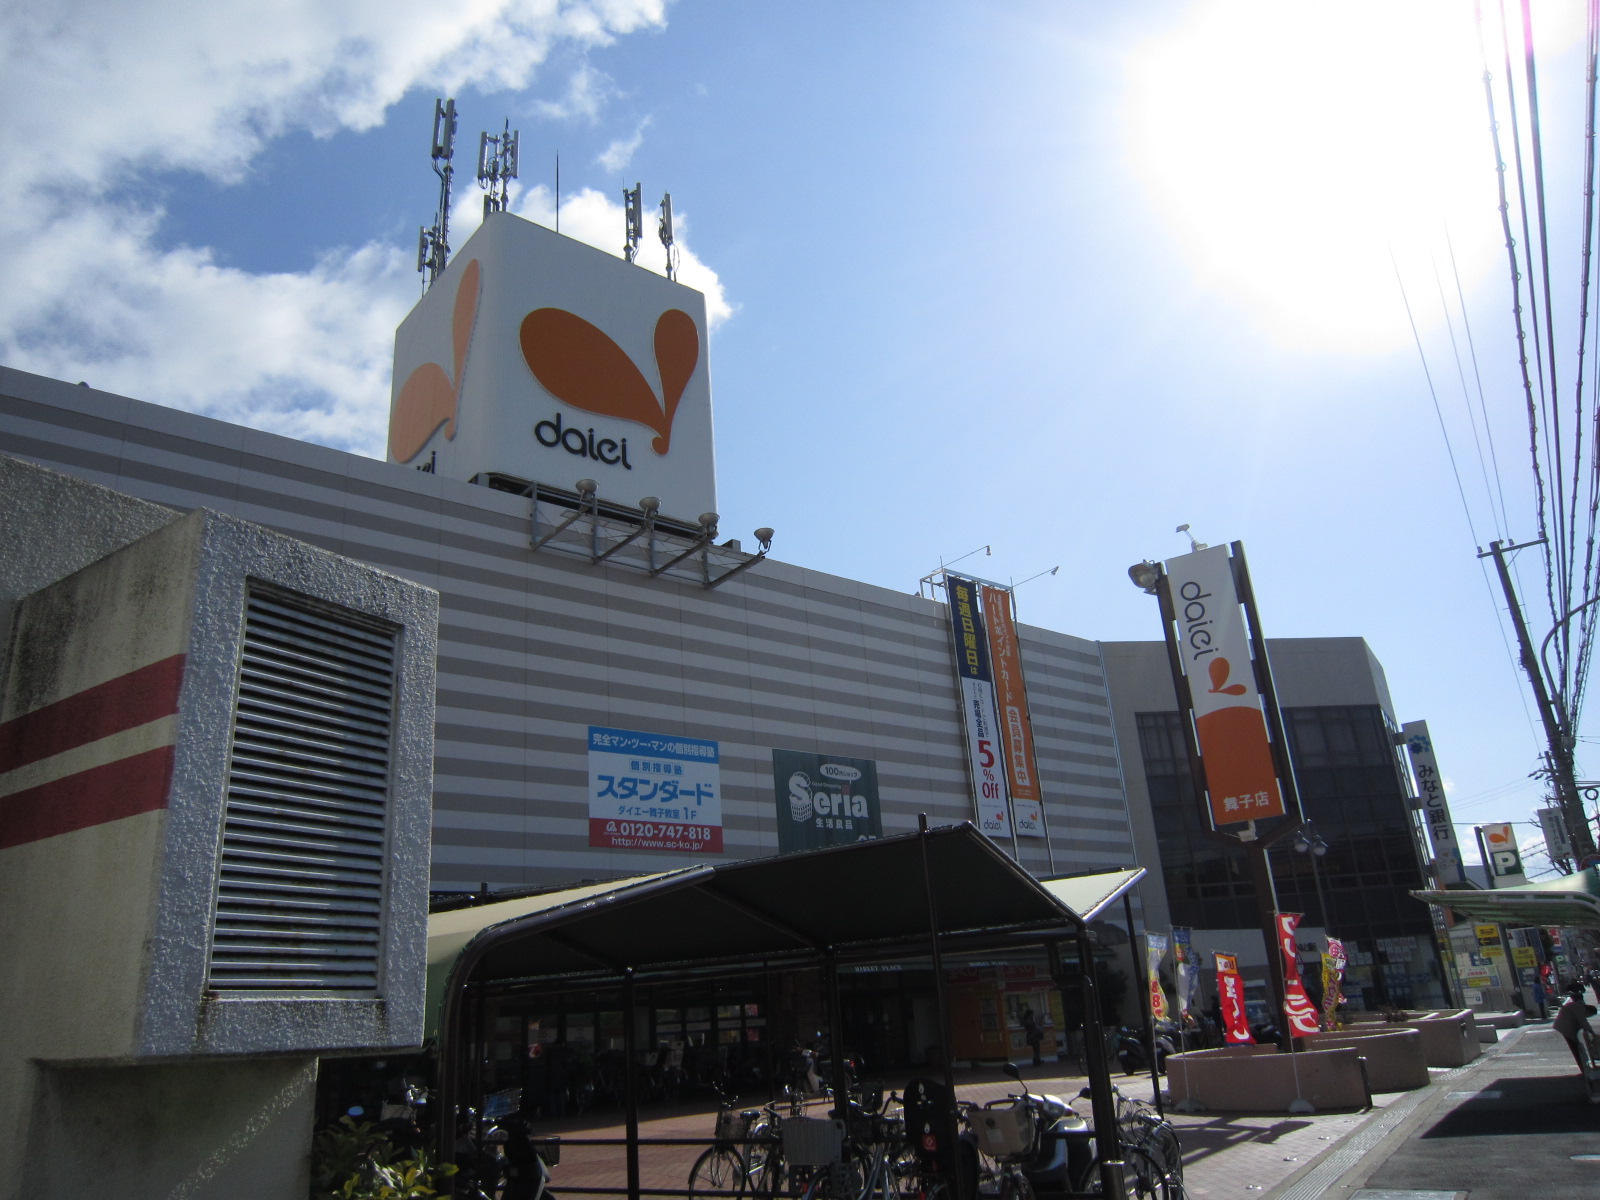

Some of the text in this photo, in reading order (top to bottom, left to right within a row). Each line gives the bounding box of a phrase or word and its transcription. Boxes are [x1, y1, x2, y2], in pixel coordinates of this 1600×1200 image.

[534, 412, 632, 470] daiei
[955, 585, 979, 675] 毎週日曜日は
[1180, 581, 1220, 661] daiei
[597, 774, 714, 806] スタンダード
[788, 771, 869, 822] Seria
[1222, 790, 1270, 813] 舞子店
[1418, 764, 1450, 841] みなと銀行
[611, 836, 704, 850] http://www.sc-ko.jp/
[620, 822, 711, 840] 0120-747-818
[1493, 852, 1517, 876] P
